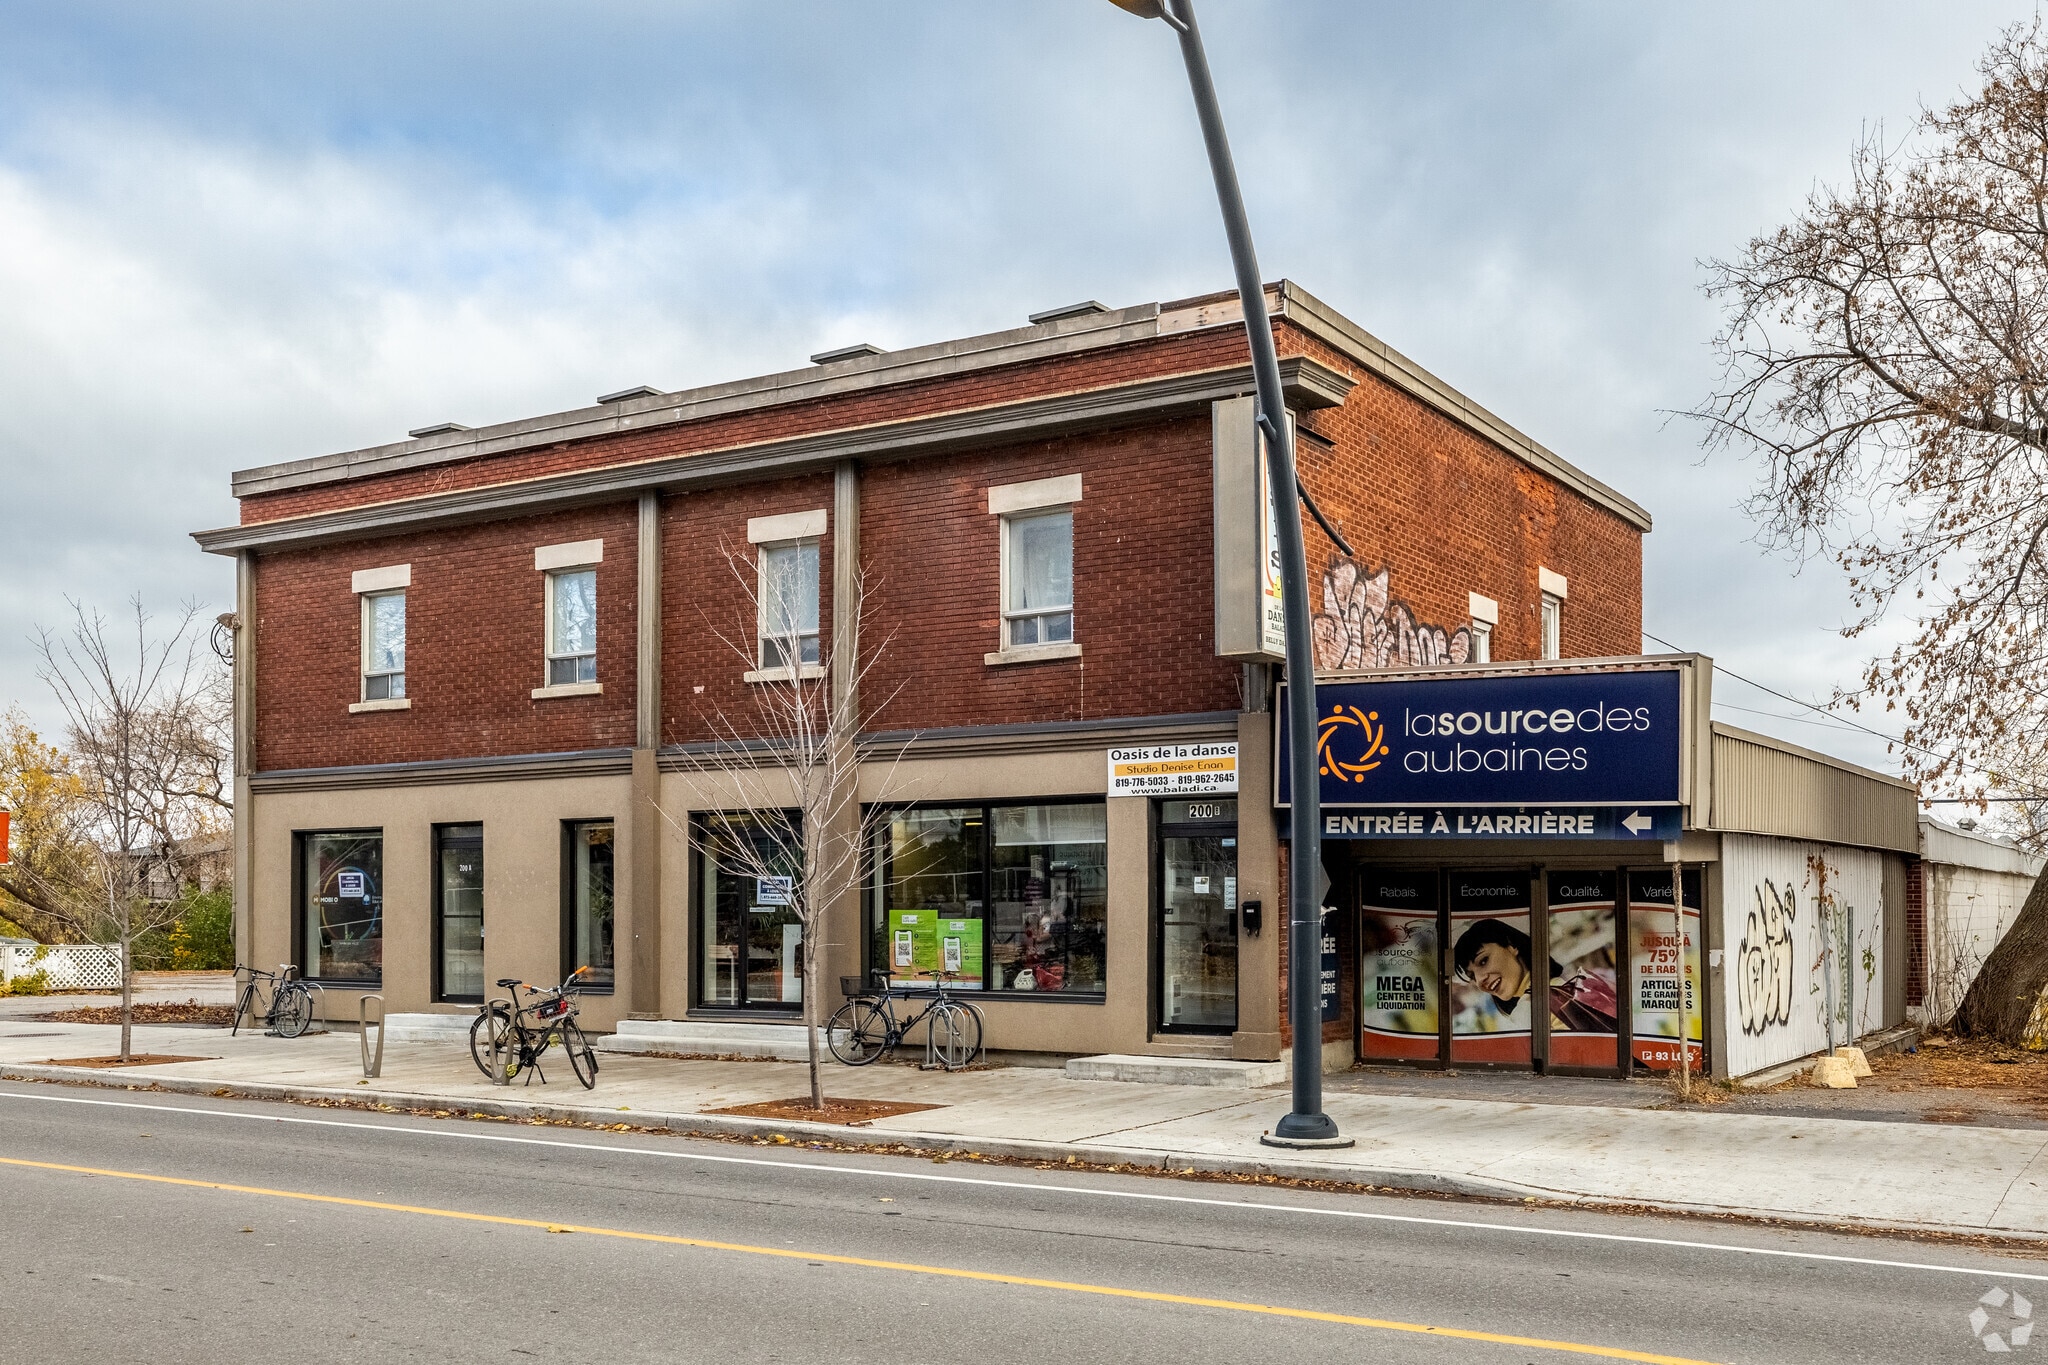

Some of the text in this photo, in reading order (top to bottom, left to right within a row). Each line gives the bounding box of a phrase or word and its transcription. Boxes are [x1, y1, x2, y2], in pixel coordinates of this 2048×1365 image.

[1111, 745, 1236, 760] Oasis de la danse
[1404, 741, 1588, 774] aubaines
[1126, 765, 1158, 774] Studio
[1162, 762, 1194, 772] Denise
[1116, 776, 1168, 788] 819-776-5033
[1178, 773, 1234, 784] 819-962-2645
[1131, 785, 1217, 794] www.baladi.ca
[1190, 805, 1212, 818] 200
[1326, 810, 1594, 834] ENTRÉE À L'ARRIÈRE
[1380, 886, 1418, 897] Rabais.
[1461, 884, 1519, 896] Économie.
[1560, 886, 1603, 897] Qualité.
[1642, 886, 1687, 898] Varié.
[1640, 934, 1691, 948] JUSQUÀ
[1641, 965, 1692, 974] DE RABIS
[1376, 976, 1424, 992] MEGA
[1642, 980, 1692, 990] ARTICLS
[1377, 992, 1425, 1001] CENTRE DE
[1376, 1002, 1425, 1010] LIQUIDATION
[1642, 1000, 1692, 1009] MARQUS
[1656, 1052, 1668, 1060] 93
[1672, 1052, 1694, 1061] LS
